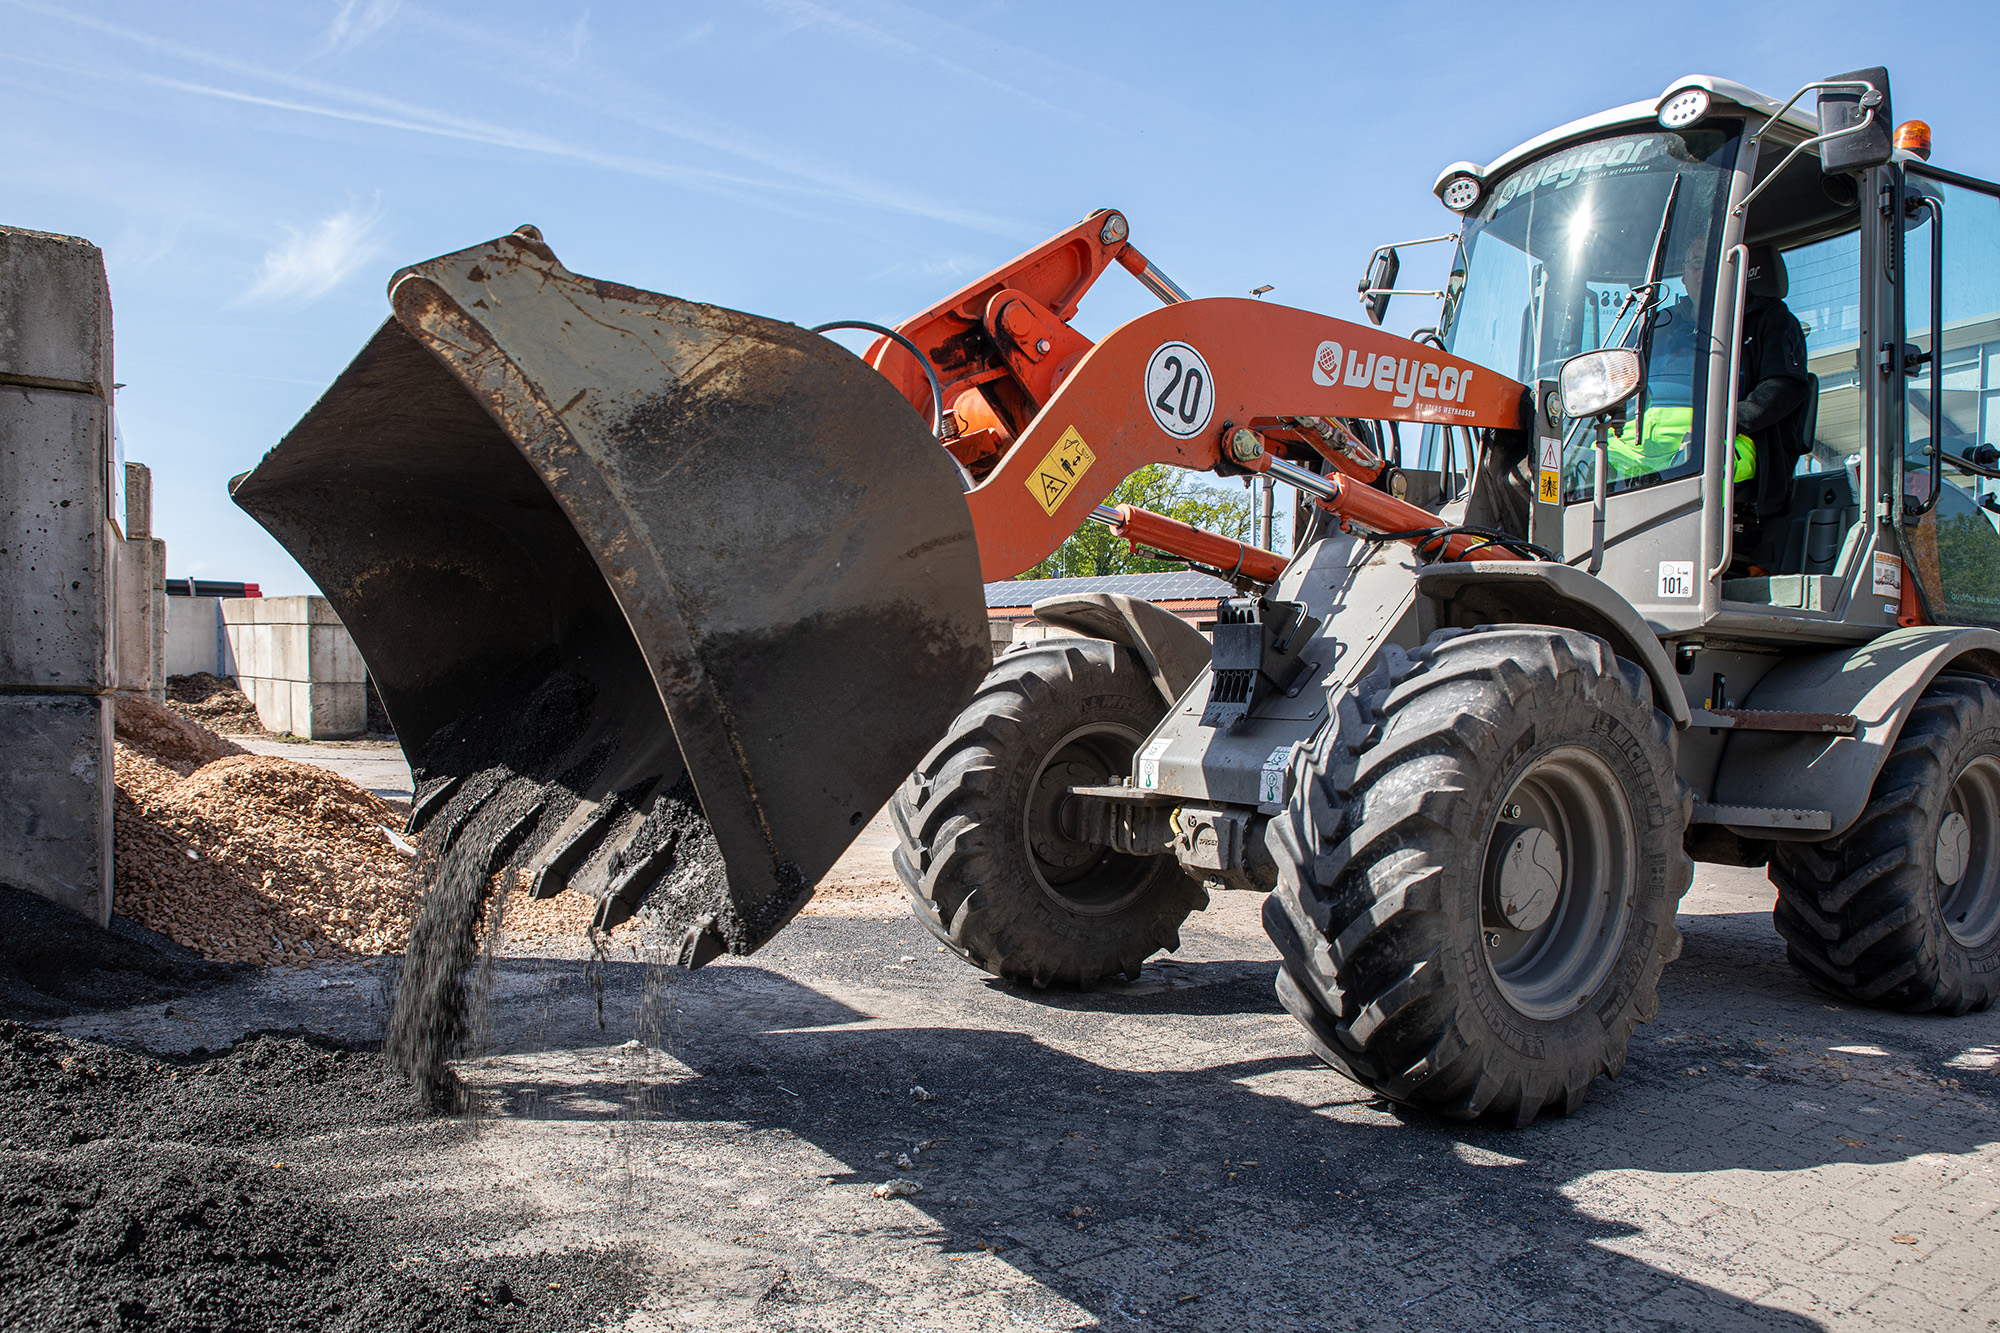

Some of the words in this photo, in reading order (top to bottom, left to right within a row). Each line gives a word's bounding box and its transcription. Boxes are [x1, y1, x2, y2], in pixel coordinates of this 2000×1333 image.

[1516, 138, 1654, 198] weycor
[1156, 355, 1203, 424] 20
[1343, 350, 1474, 408] weycor
[1415, 402, 1423, 410] BY
[1424, 404, 1442, 413] ATLAS
[1443, 406, 1476, 418] WEYHAUSEN
[1662, 576, 1681, 594] 101
[1608, 723, 1665, 826] MICHELIN
[1464, 950, 1525, 1050] MICHELIN
